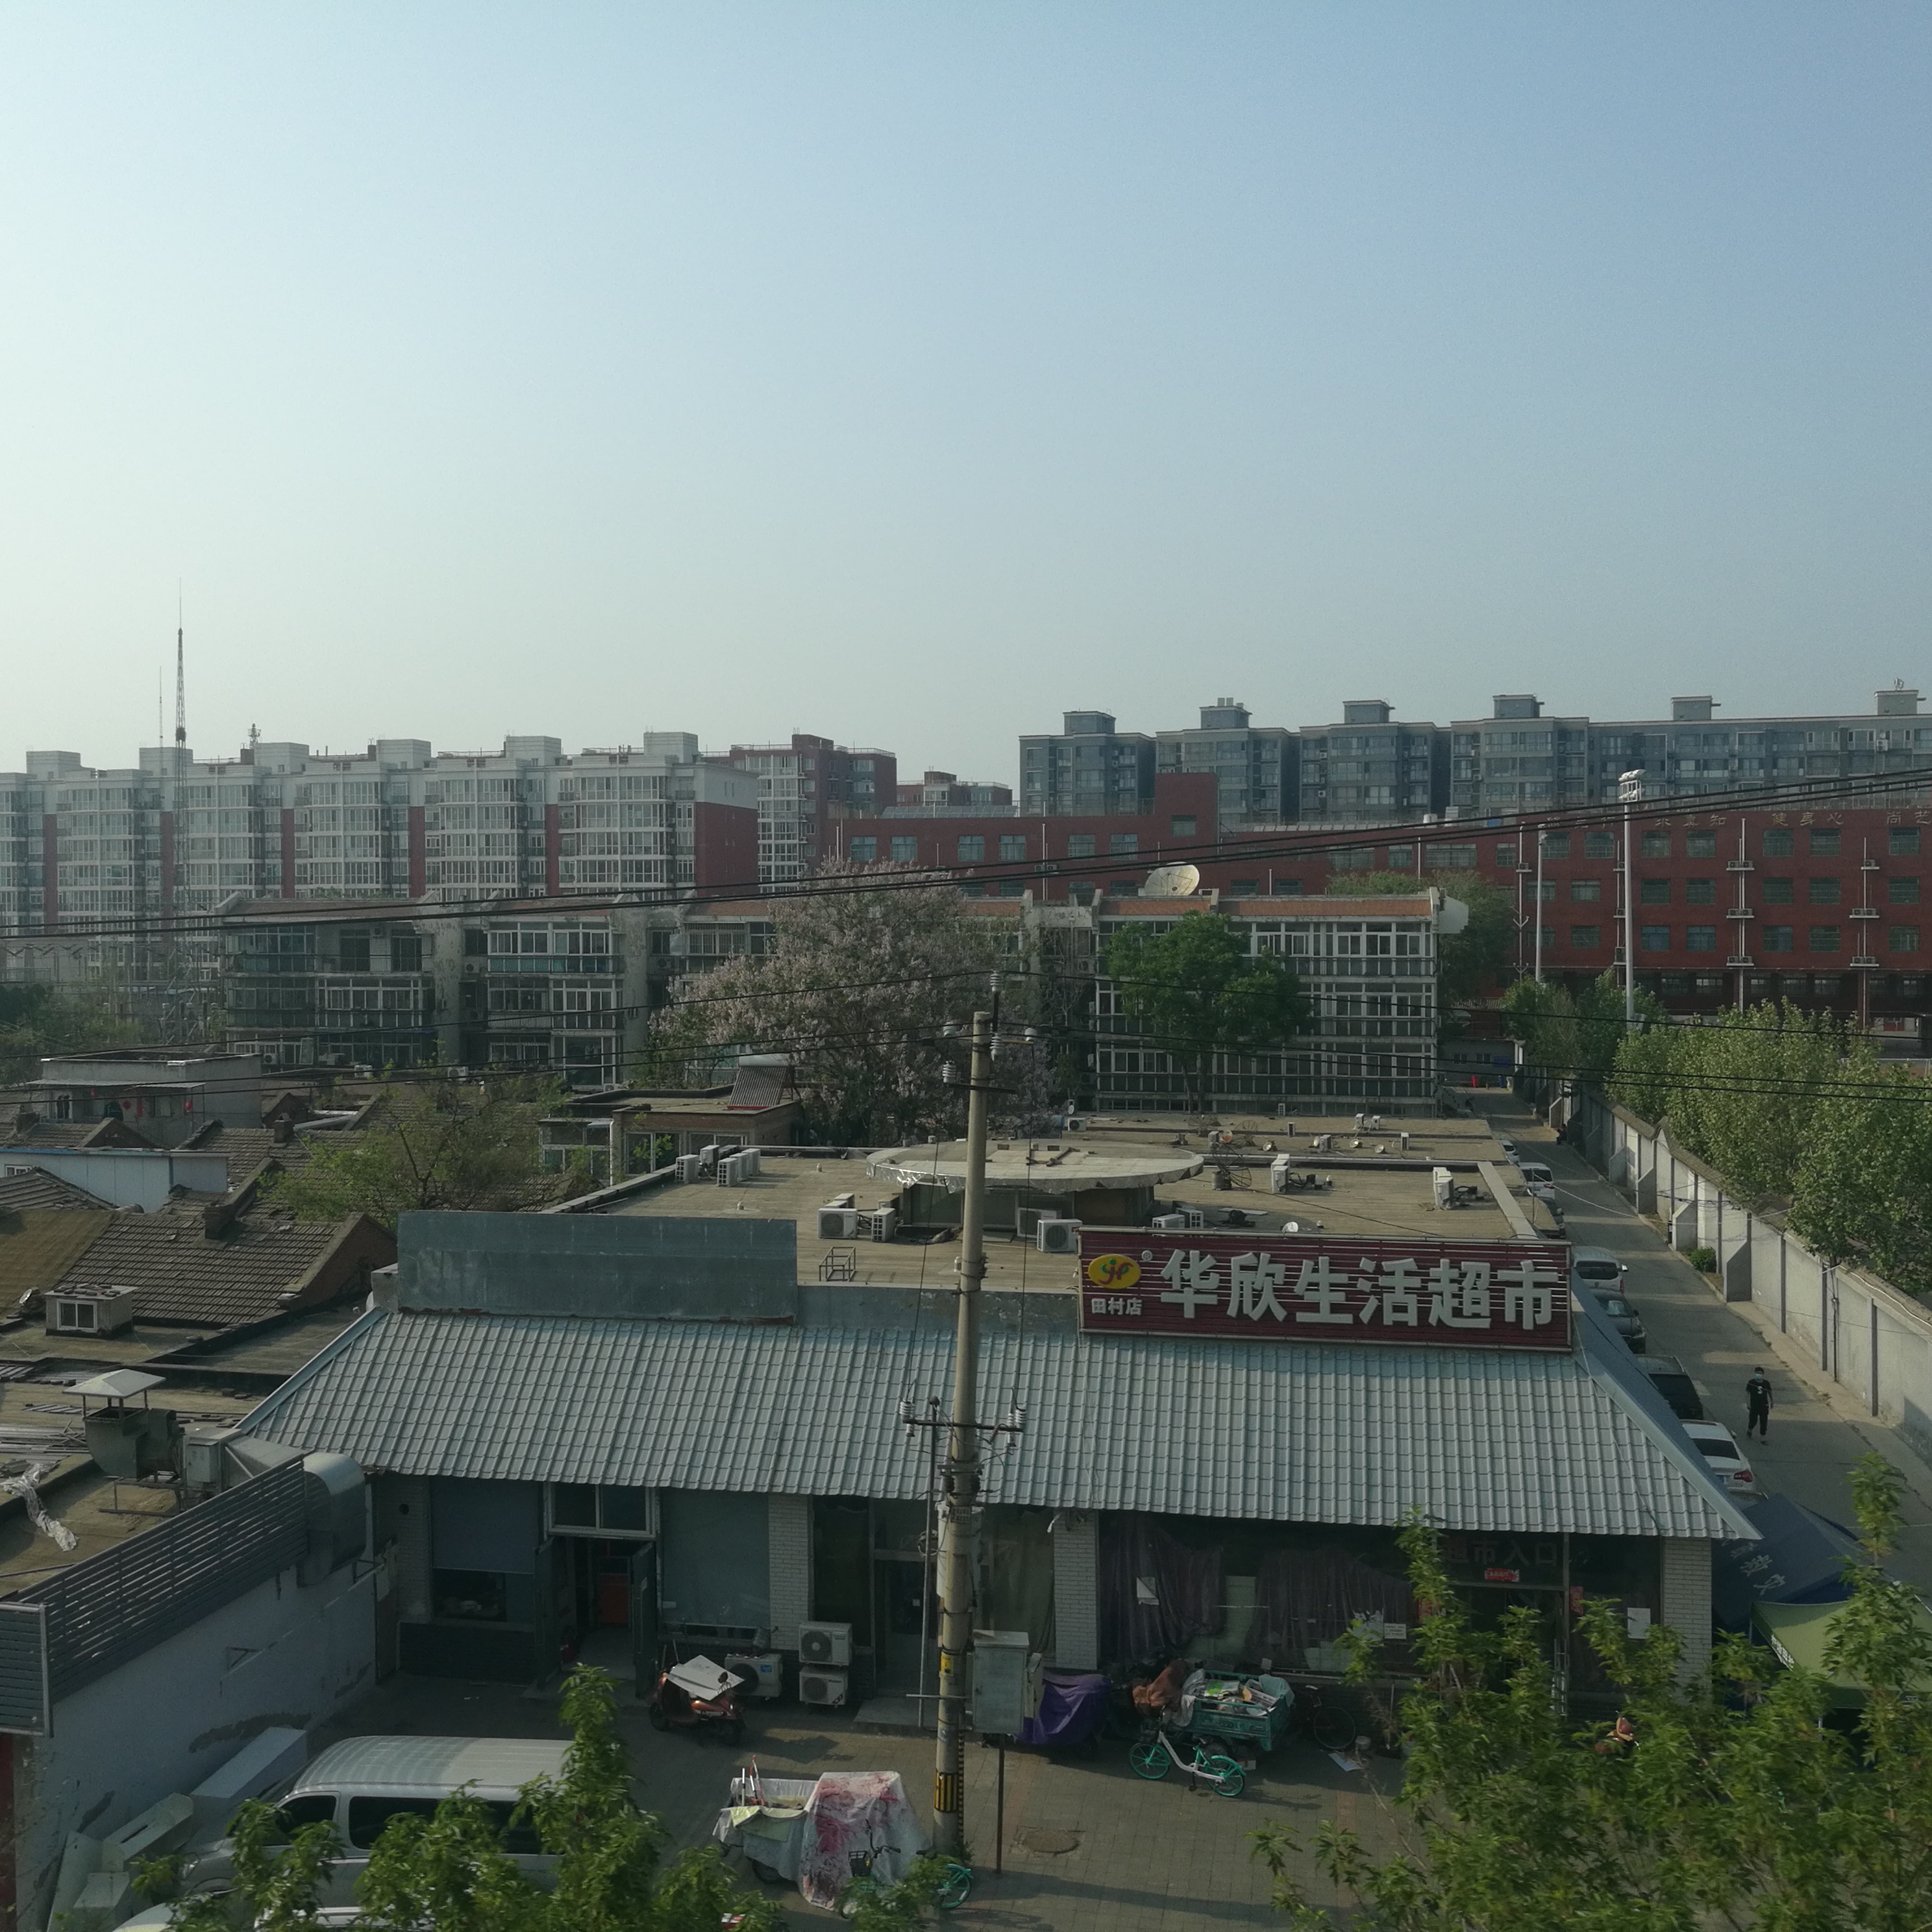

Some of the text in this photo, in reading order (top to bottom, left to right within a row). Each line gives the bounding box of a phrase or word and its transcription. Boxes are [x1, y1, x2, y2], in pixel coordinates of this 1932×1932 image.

[1771, 811, 1844, 826] 健身心
[1160, 1249, 1558, 1330] 华欣生活超市
[1091, 1297, 1143, 1315] 田村店
